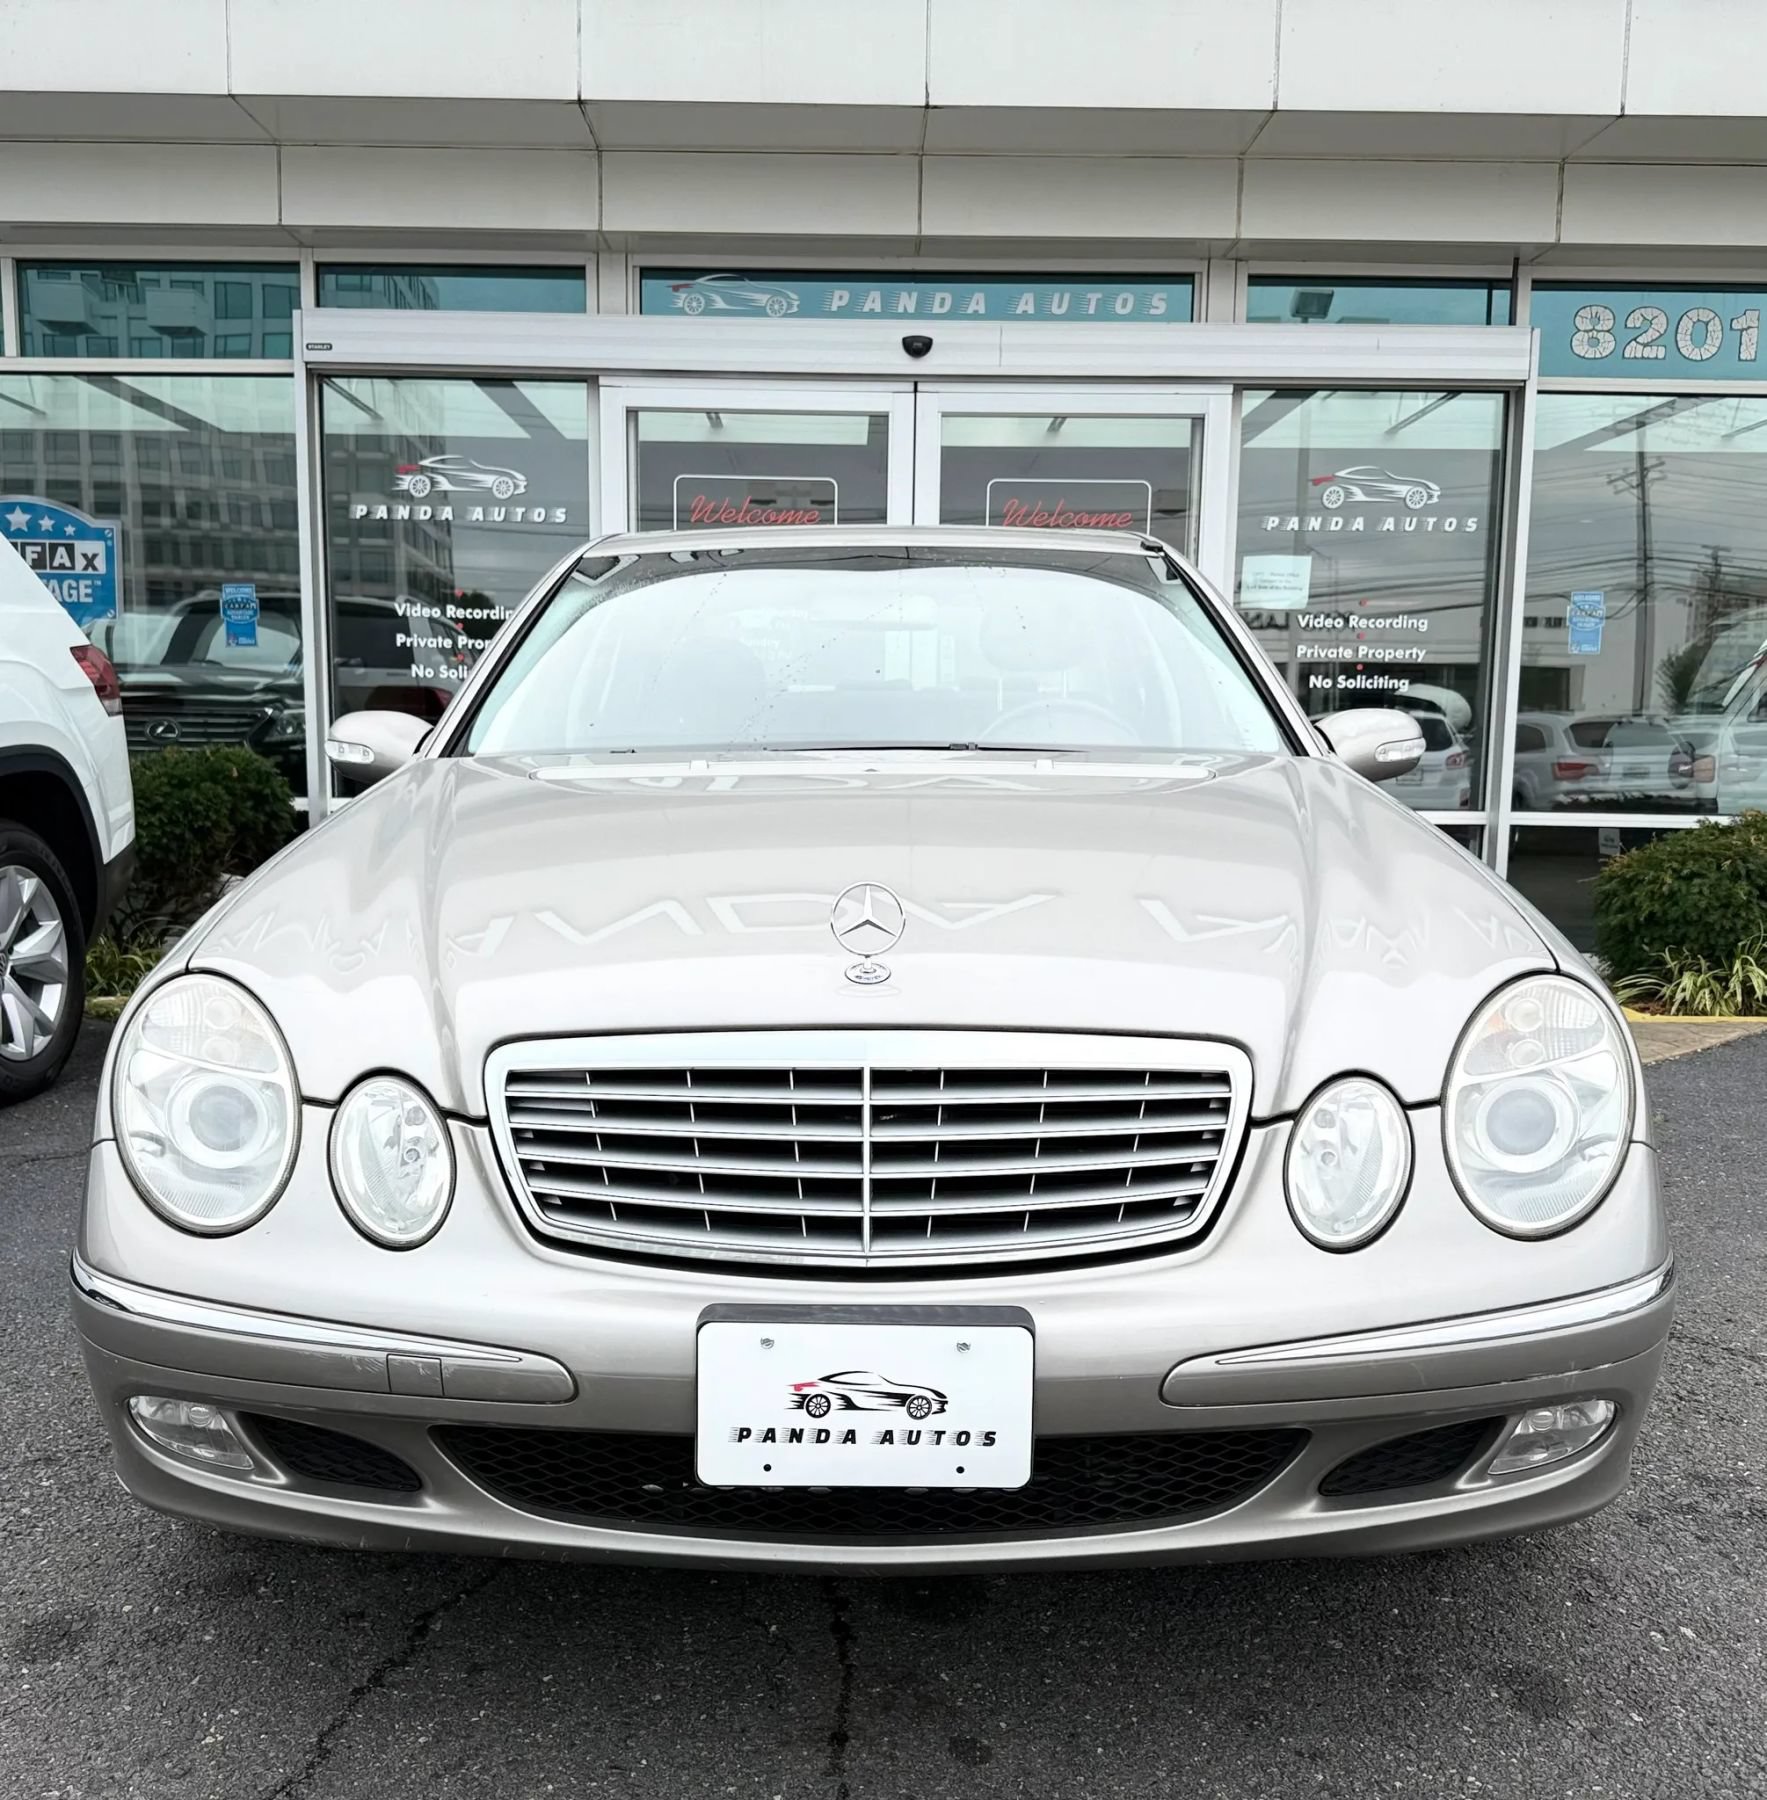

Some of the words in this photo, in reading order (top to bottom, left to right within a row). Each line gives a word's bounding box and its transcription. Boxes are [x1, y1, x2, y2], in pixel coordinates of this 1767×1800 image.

[826, 289, 986, 314] PANDA
[1010, 291, 1167, 315] AUTOS
[1570, 304, 1761, 362] 8201
[351, 504, 454, 520] PANDA
[469, 506, 567, 523] AUTOS
[690, 495, 821, 525] Welcome
[1002, 498, 1134, 528] Welcome
[1263, 516, 1365, 531] PANDA
[1379, 517, 1479, 532] AUTOS
[25, 545, 100, 572] FAX
[394, 602, 441, 618] Video
[1297, 614, 1344, 628] Video
[1349, 615, 1428, 632] Recording
[396, 633, 453, 649] Private
[1296, 644, 1353, 659] Private
[1358, 645, 1427, 662] Property
[411, 664, 434, 678] No
[1309, 674, 1333, 689] No
[1337, 674, 1410, 692] Soliciting
[730, 1427, 857, 1445] PANDA
[872, 1430, 997, 1447] AUTOS
